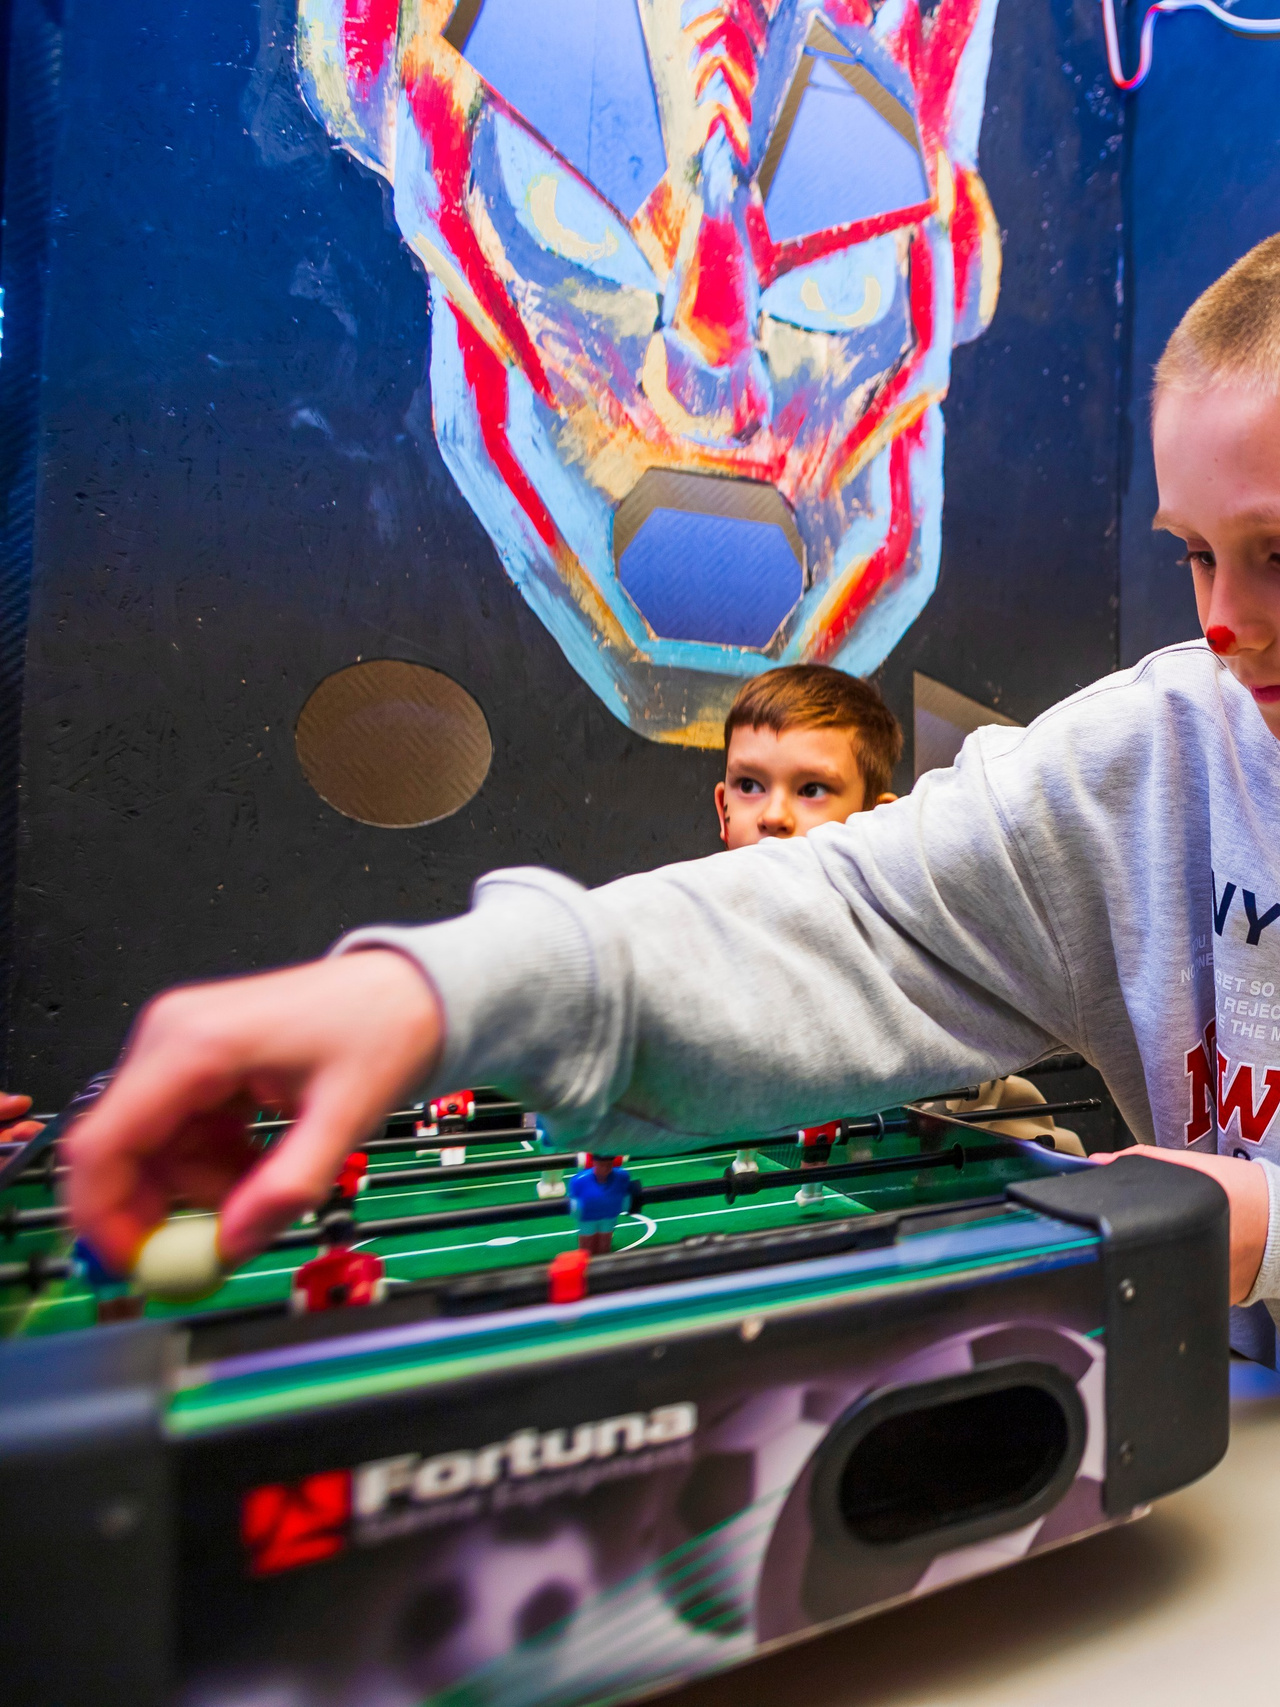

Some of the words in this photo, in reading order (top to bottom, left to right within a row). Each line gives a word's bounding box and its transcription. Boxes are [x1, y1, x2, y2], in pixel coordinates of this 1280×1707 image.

[1215, 969, 1246, 992] GET
[1249, 980, 1275, 997] SO
[1230, 1019, 1267, 1040] THE
[353, 1400, 698, 1517] Fortuna
